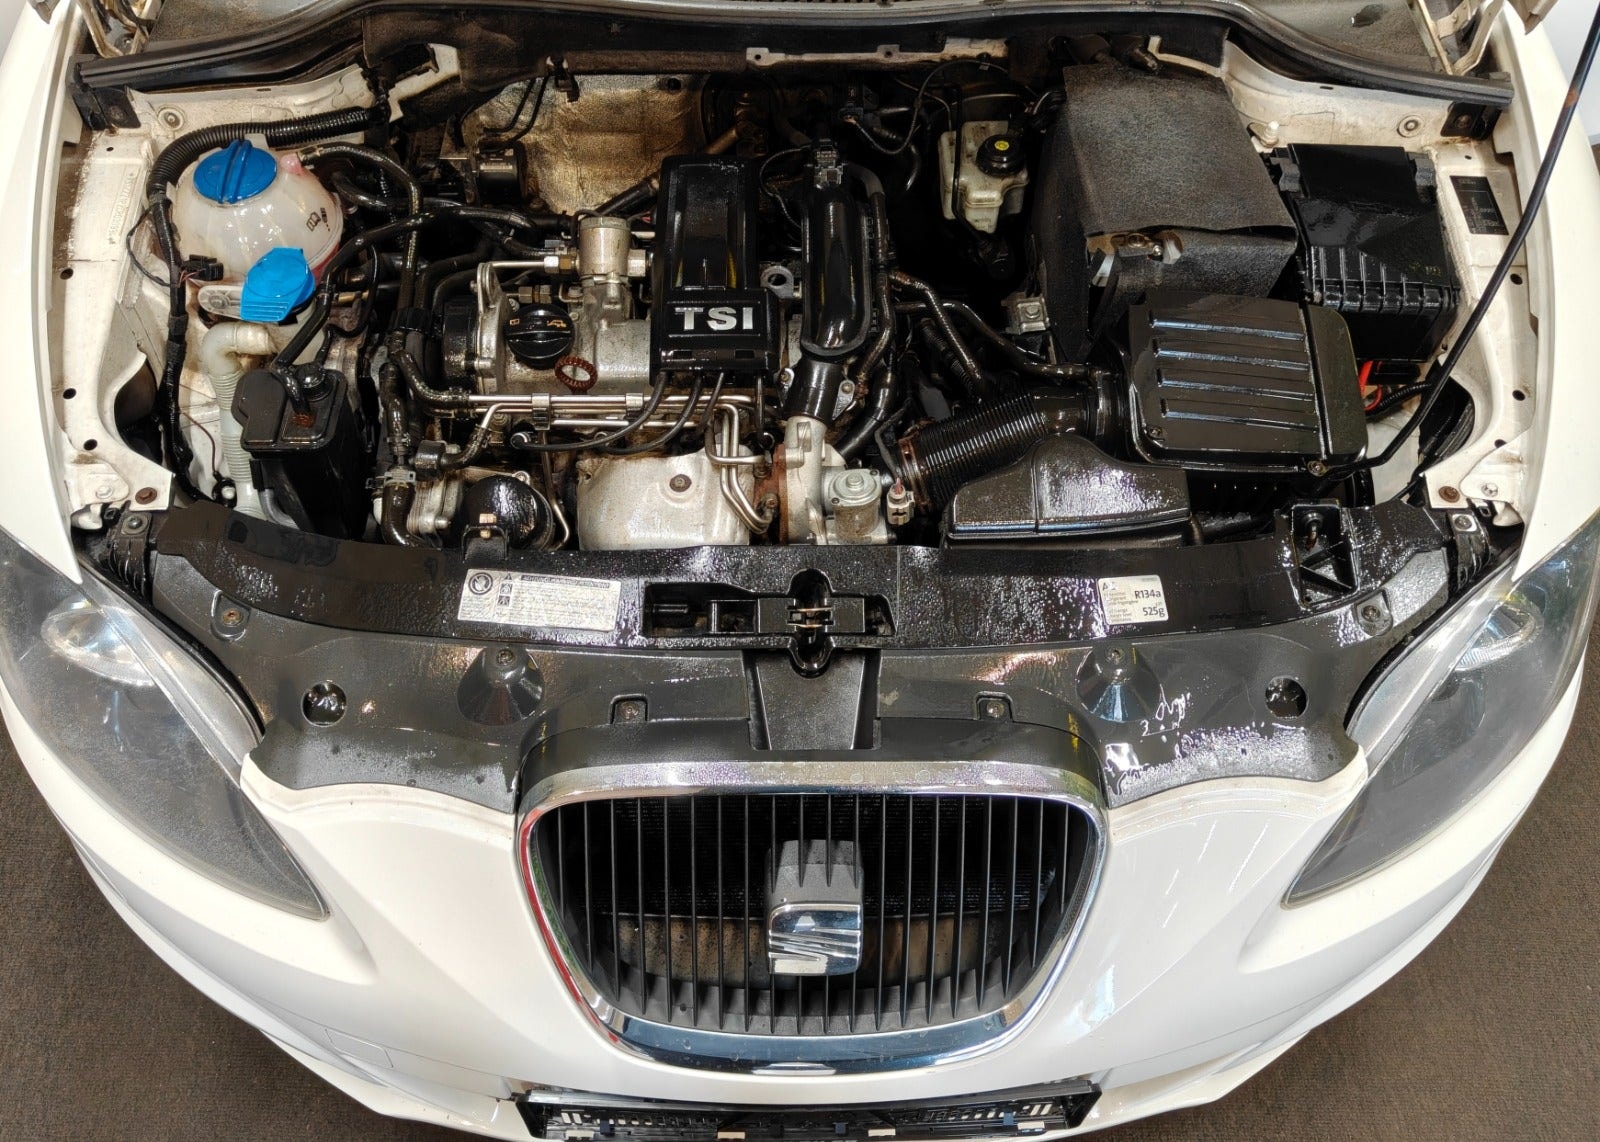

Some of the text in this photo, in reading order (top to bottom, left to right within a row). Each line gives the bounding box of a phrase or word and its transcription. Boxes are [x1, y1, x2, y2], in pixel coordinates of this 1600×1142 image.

[675, 306, 754, 331] TSI
[1134, 590, 1161, 599] R134a
[1142, 607, 1165, 617] 525g
